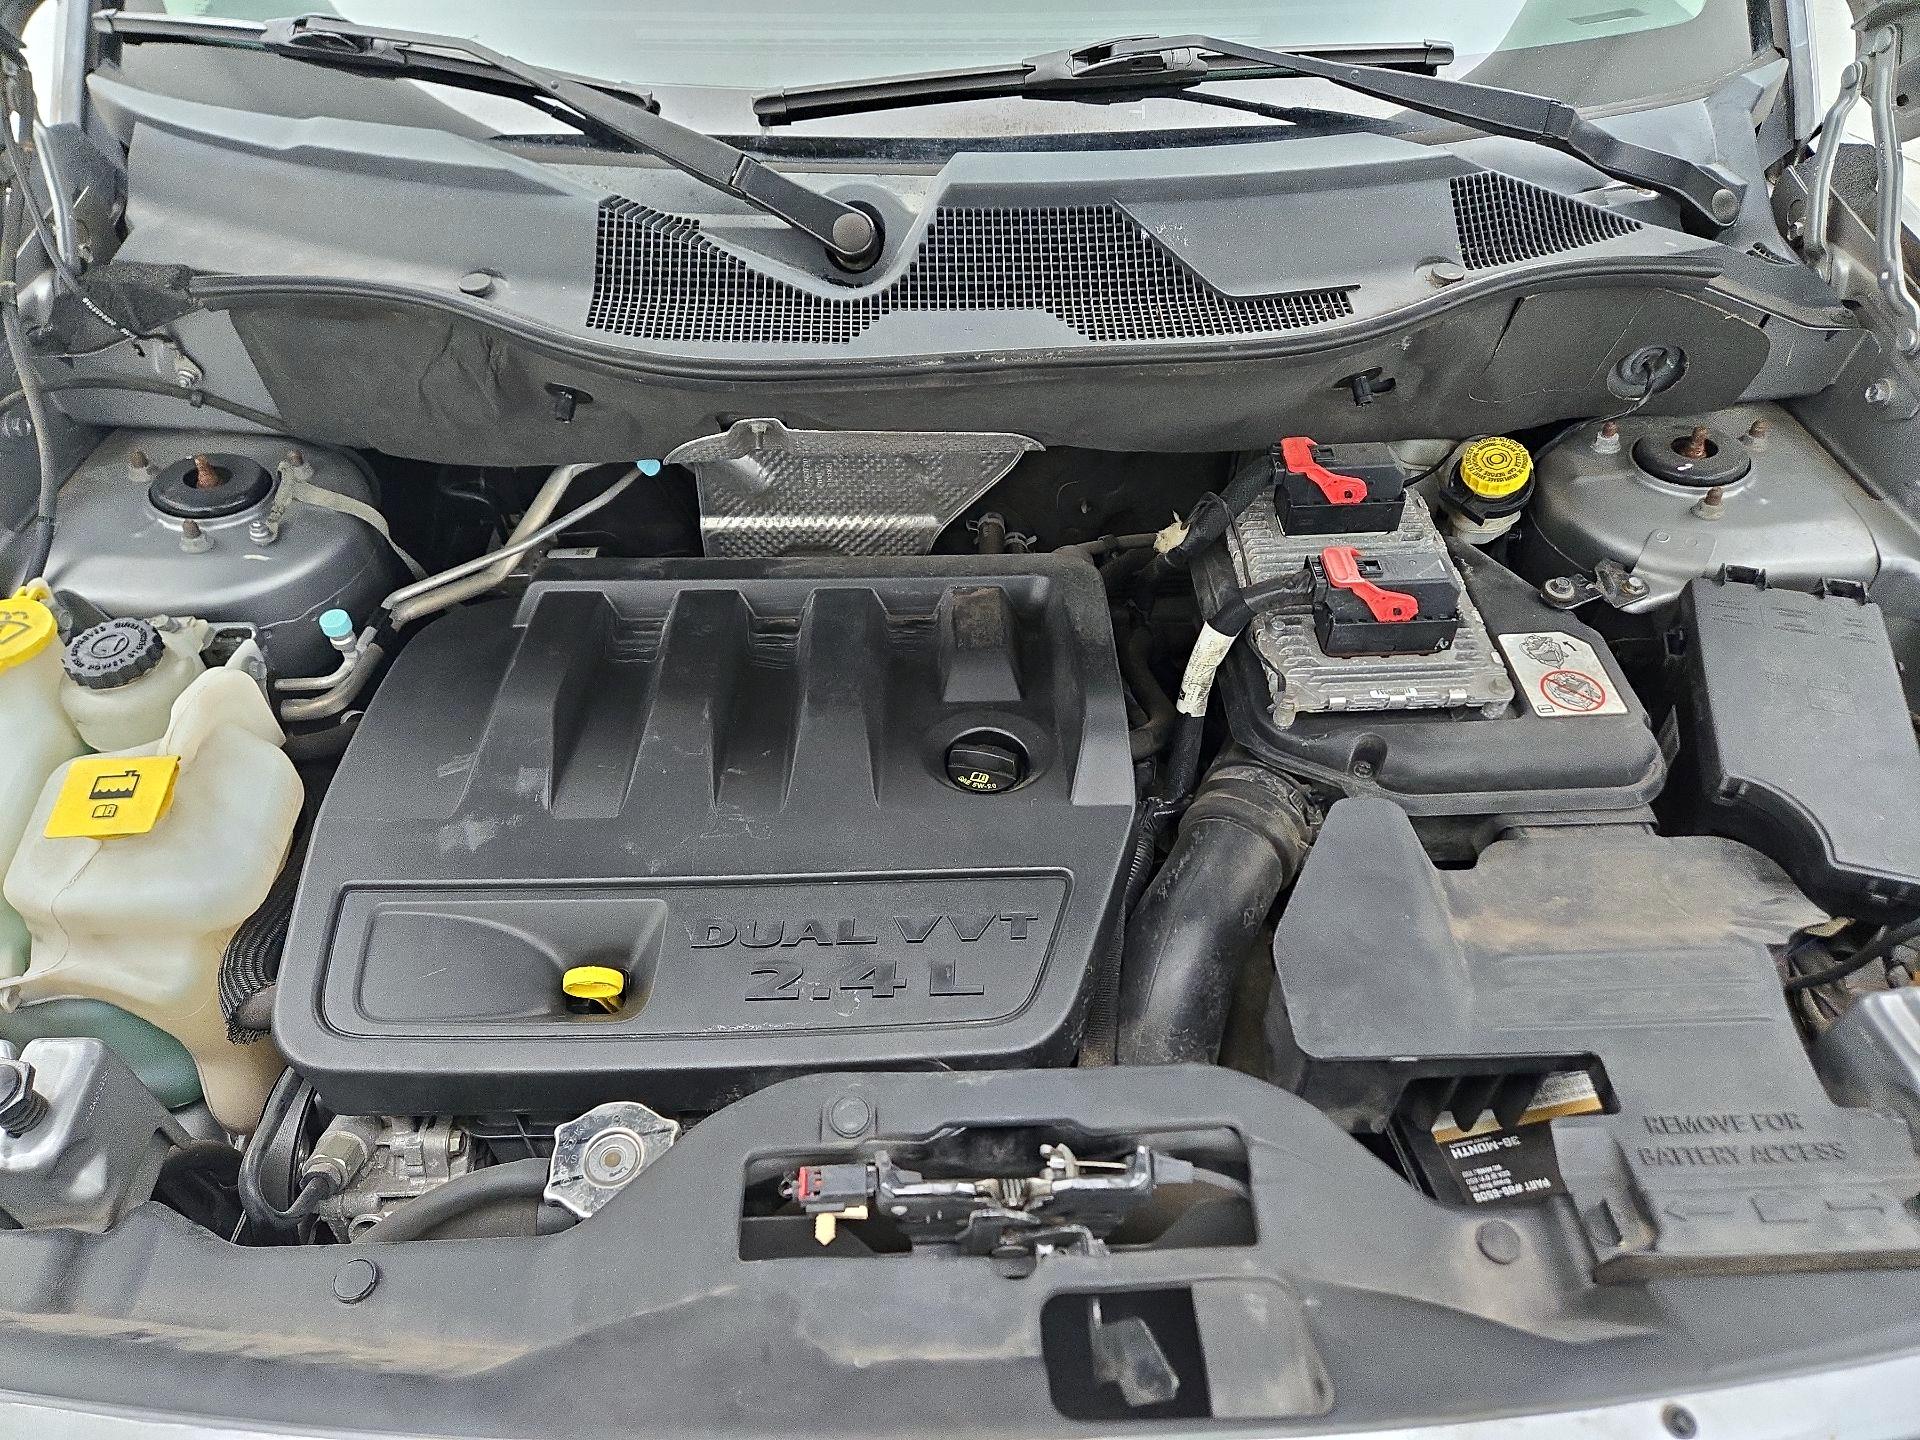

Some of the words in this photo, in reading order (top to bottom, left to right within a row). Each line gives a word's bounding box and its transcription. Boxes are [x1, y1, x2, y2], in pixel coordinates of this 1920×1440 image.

[957, 776, 970, 786] SAE
[691, 917, 877, 949] DUAL
[893, 912, 1039, 944] VVT
[745, 959, 907, 1001] 2.4
[929, 959, 984, 997] L
[1642, 1114, 1744, 1136] REMOVE
[1751, 1111, 1805, 1133] FOR
[1637, 1145, 1741, 1166] BATTERY
[1751, 1141, 1848, 1165] ACCESS
[1524, 1177, 1552, 1192] PART
